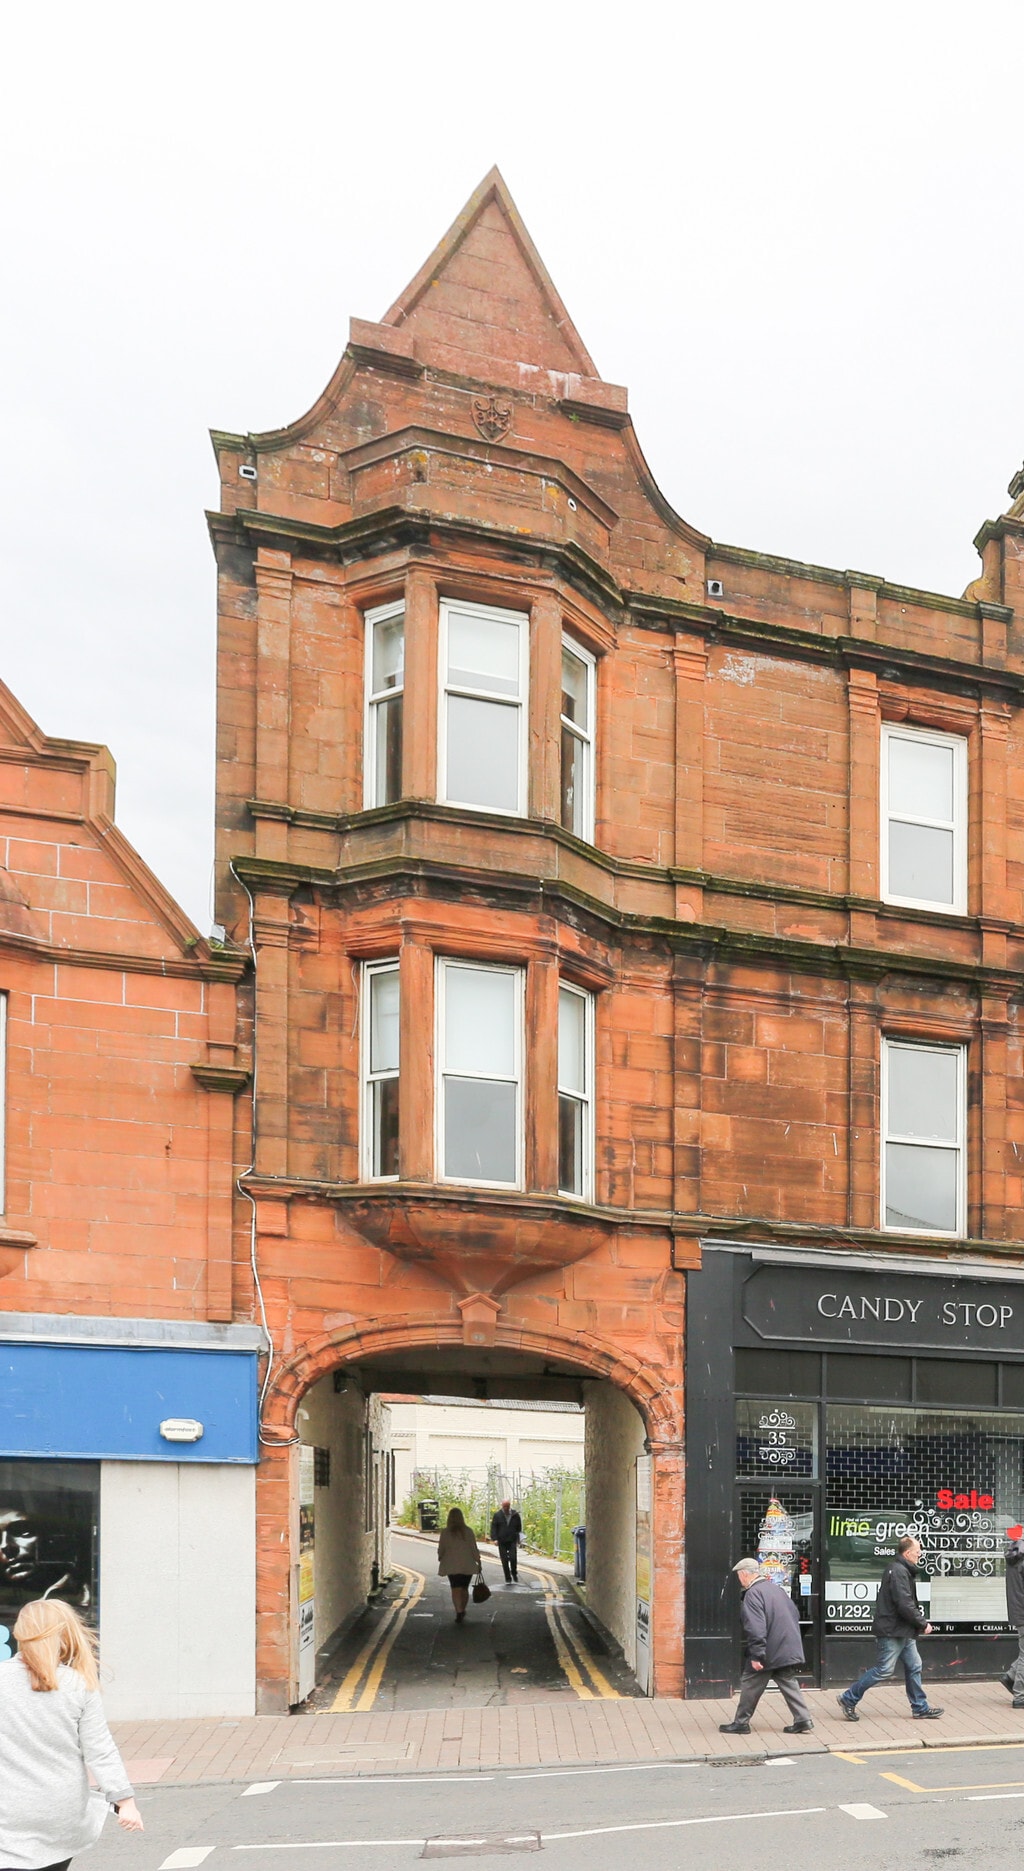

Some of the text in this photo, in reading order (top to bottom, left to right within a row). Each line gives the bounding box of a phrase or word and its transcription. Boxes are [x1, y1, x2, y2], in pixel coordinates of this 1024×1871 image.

[817, 1294, 1014, 1329] CANDY STOP
[768, 1431, 786, 1446] 35
[936, 1489, 995, 1510] Sale
[830, 1516, 870, 1536] lime
[875, 1522, 930, 1542] green
[918, 1537, 1003, 1549] ANDY STOP
[873, 1546, 896, 1556] Sales
[841, 1583, 869, 1599] TO
[827, 1605, 871, 1618] 01292
